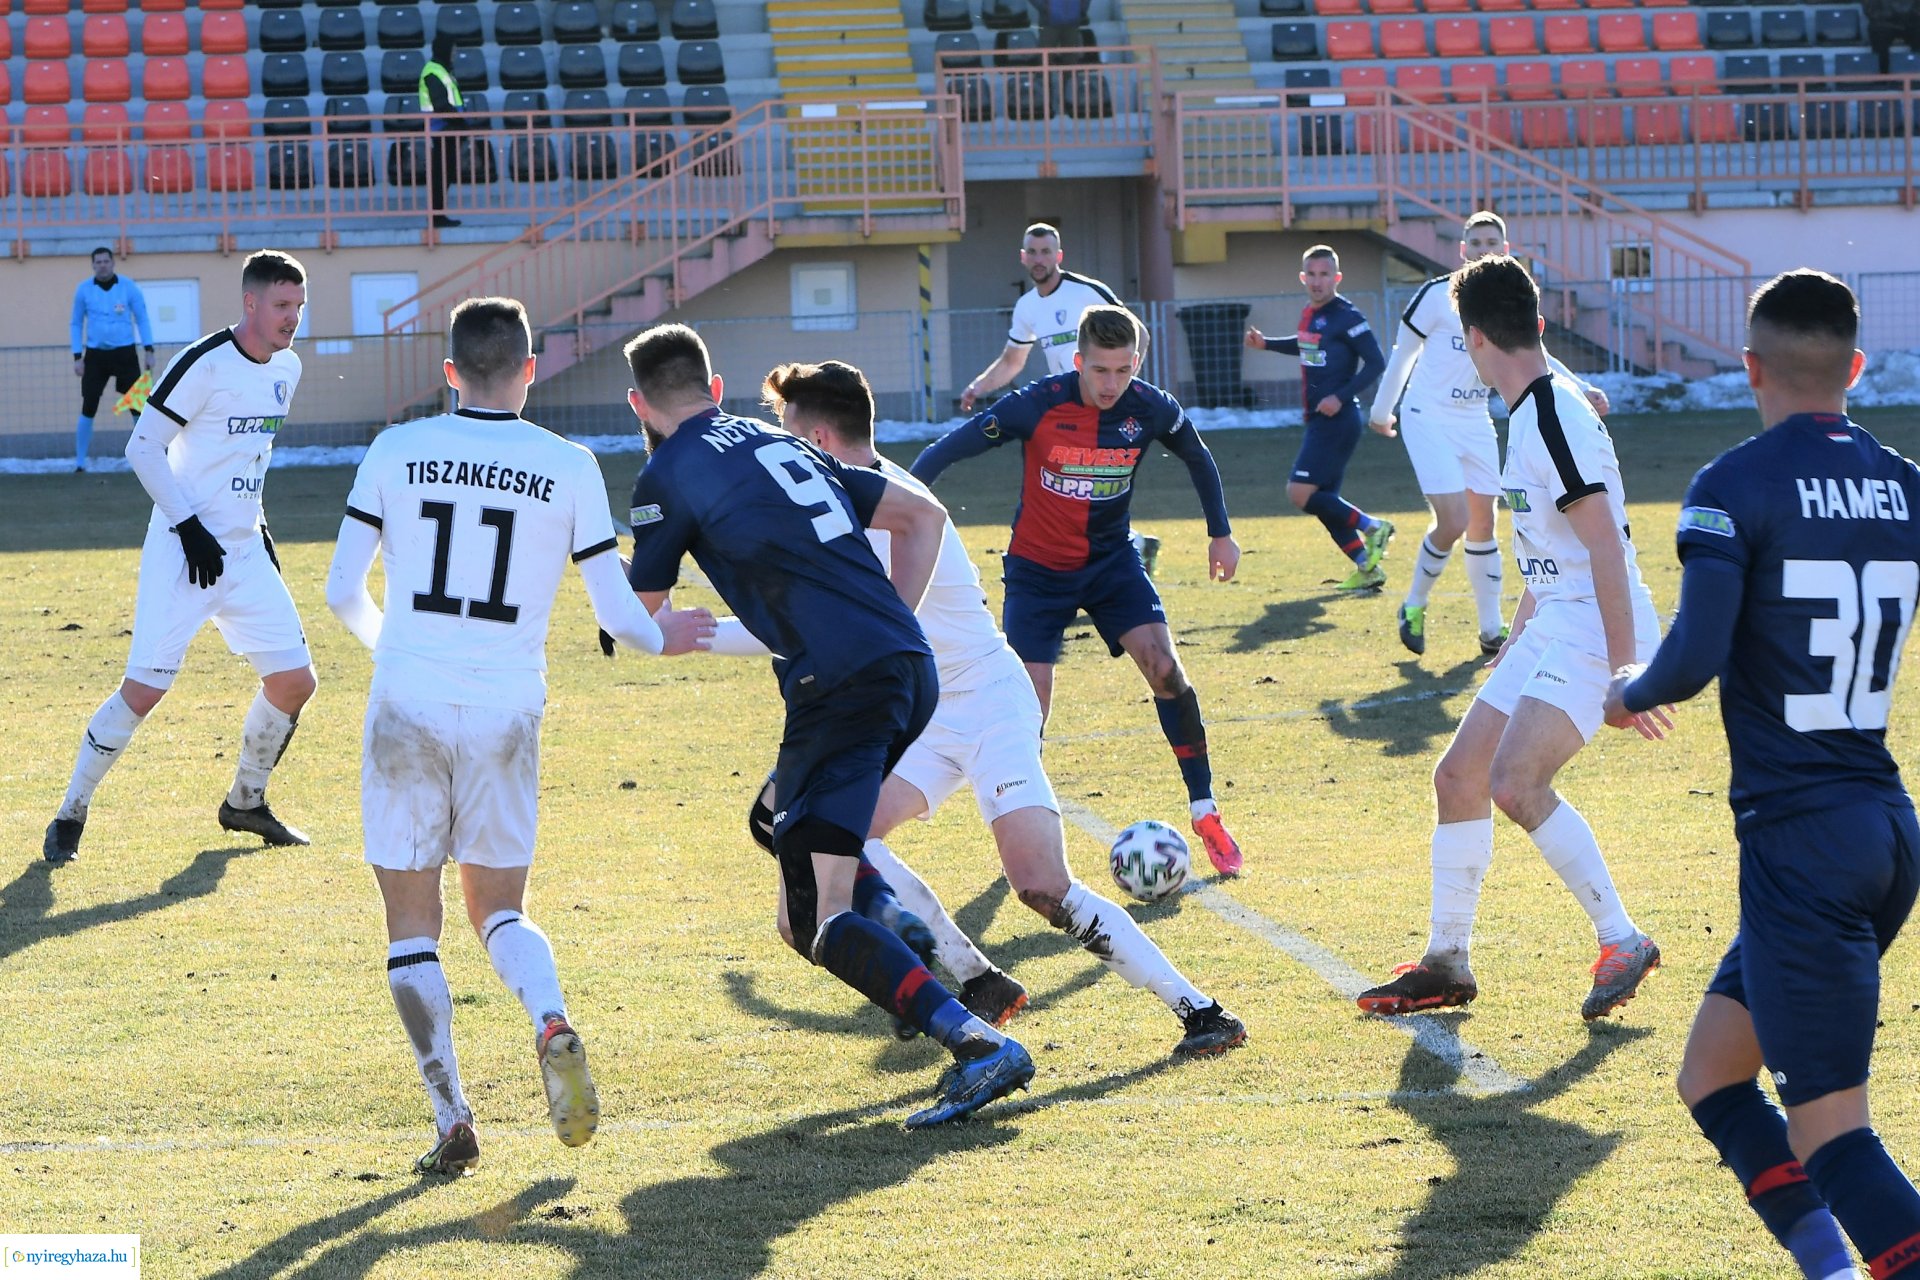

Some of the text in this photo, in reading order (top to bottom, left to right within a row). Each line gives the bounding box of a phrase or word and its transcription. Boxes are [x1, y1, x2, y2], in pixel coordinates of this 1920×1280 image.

[406, 460, 555, 503] TISZAKÉCSKE
[754, 441, 854, 543] 9
[1795, 477, 1910, 521] HAMED
[412, 498, 521, 624] 11
[1782, 559, 1919, 732] 30
